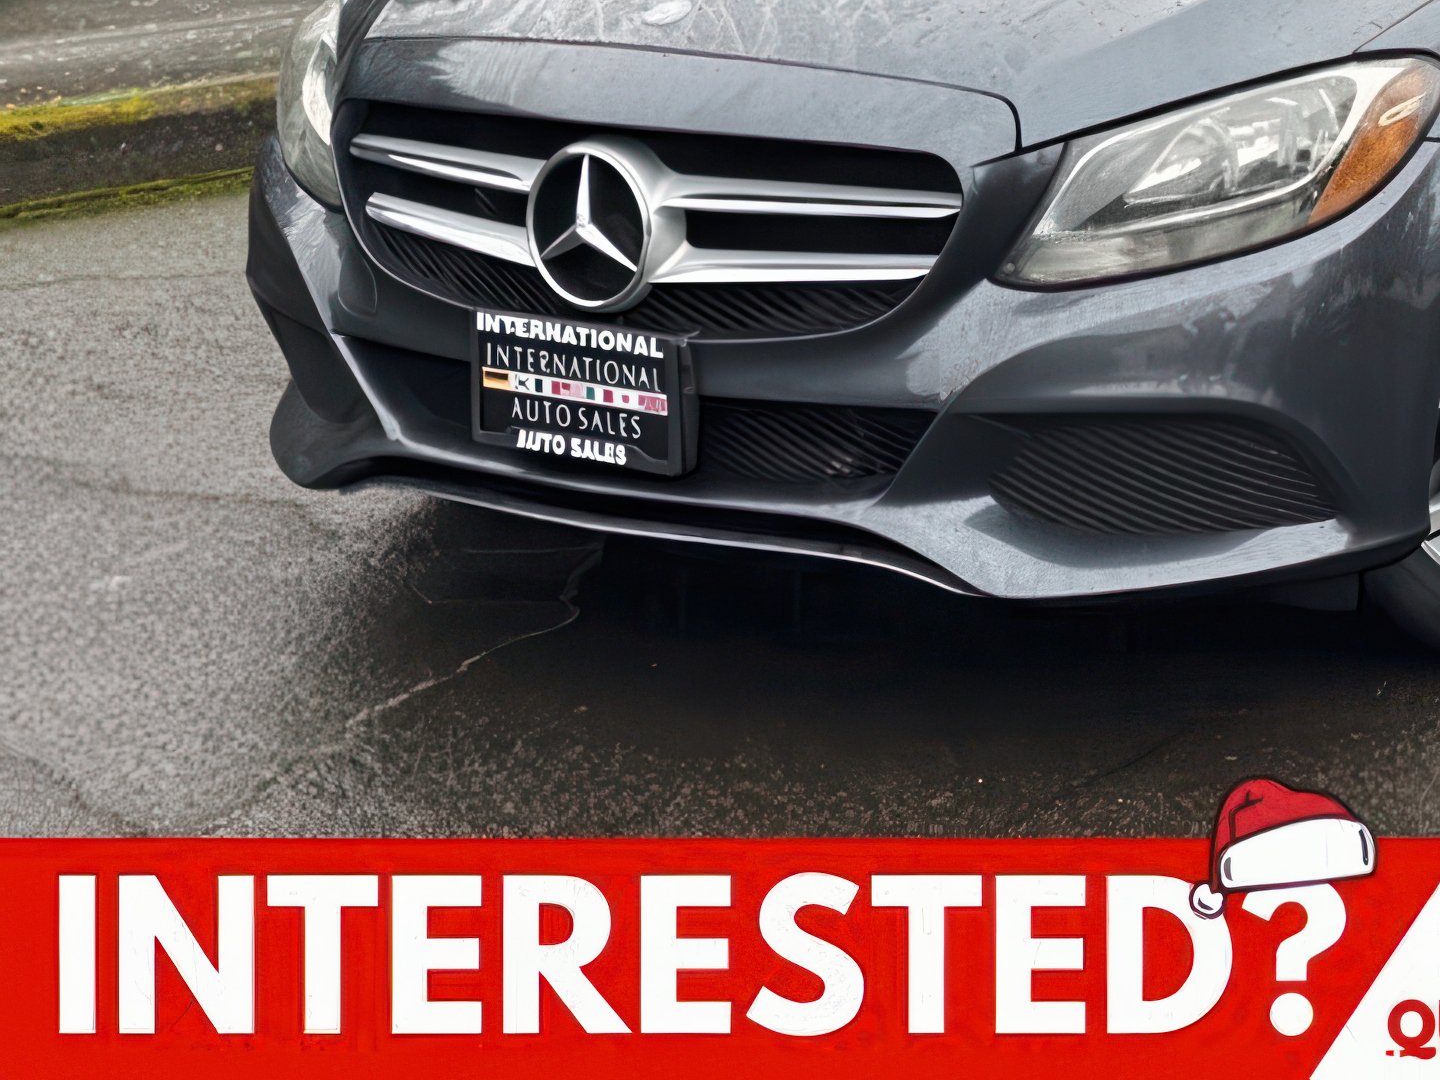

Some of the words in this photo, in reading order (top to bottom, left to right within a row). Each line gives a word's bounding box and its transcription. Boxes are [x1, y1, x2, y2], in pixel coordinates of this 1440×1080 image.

[476, 311, 664, 358] INTERNATIONAL
[487, 342, 661, 393] INTERNATIONAL
[511, 397, 572, 427] AUTO
[578, 406, 642, 439] SALES
[570, 436, 627, 465] SALES
